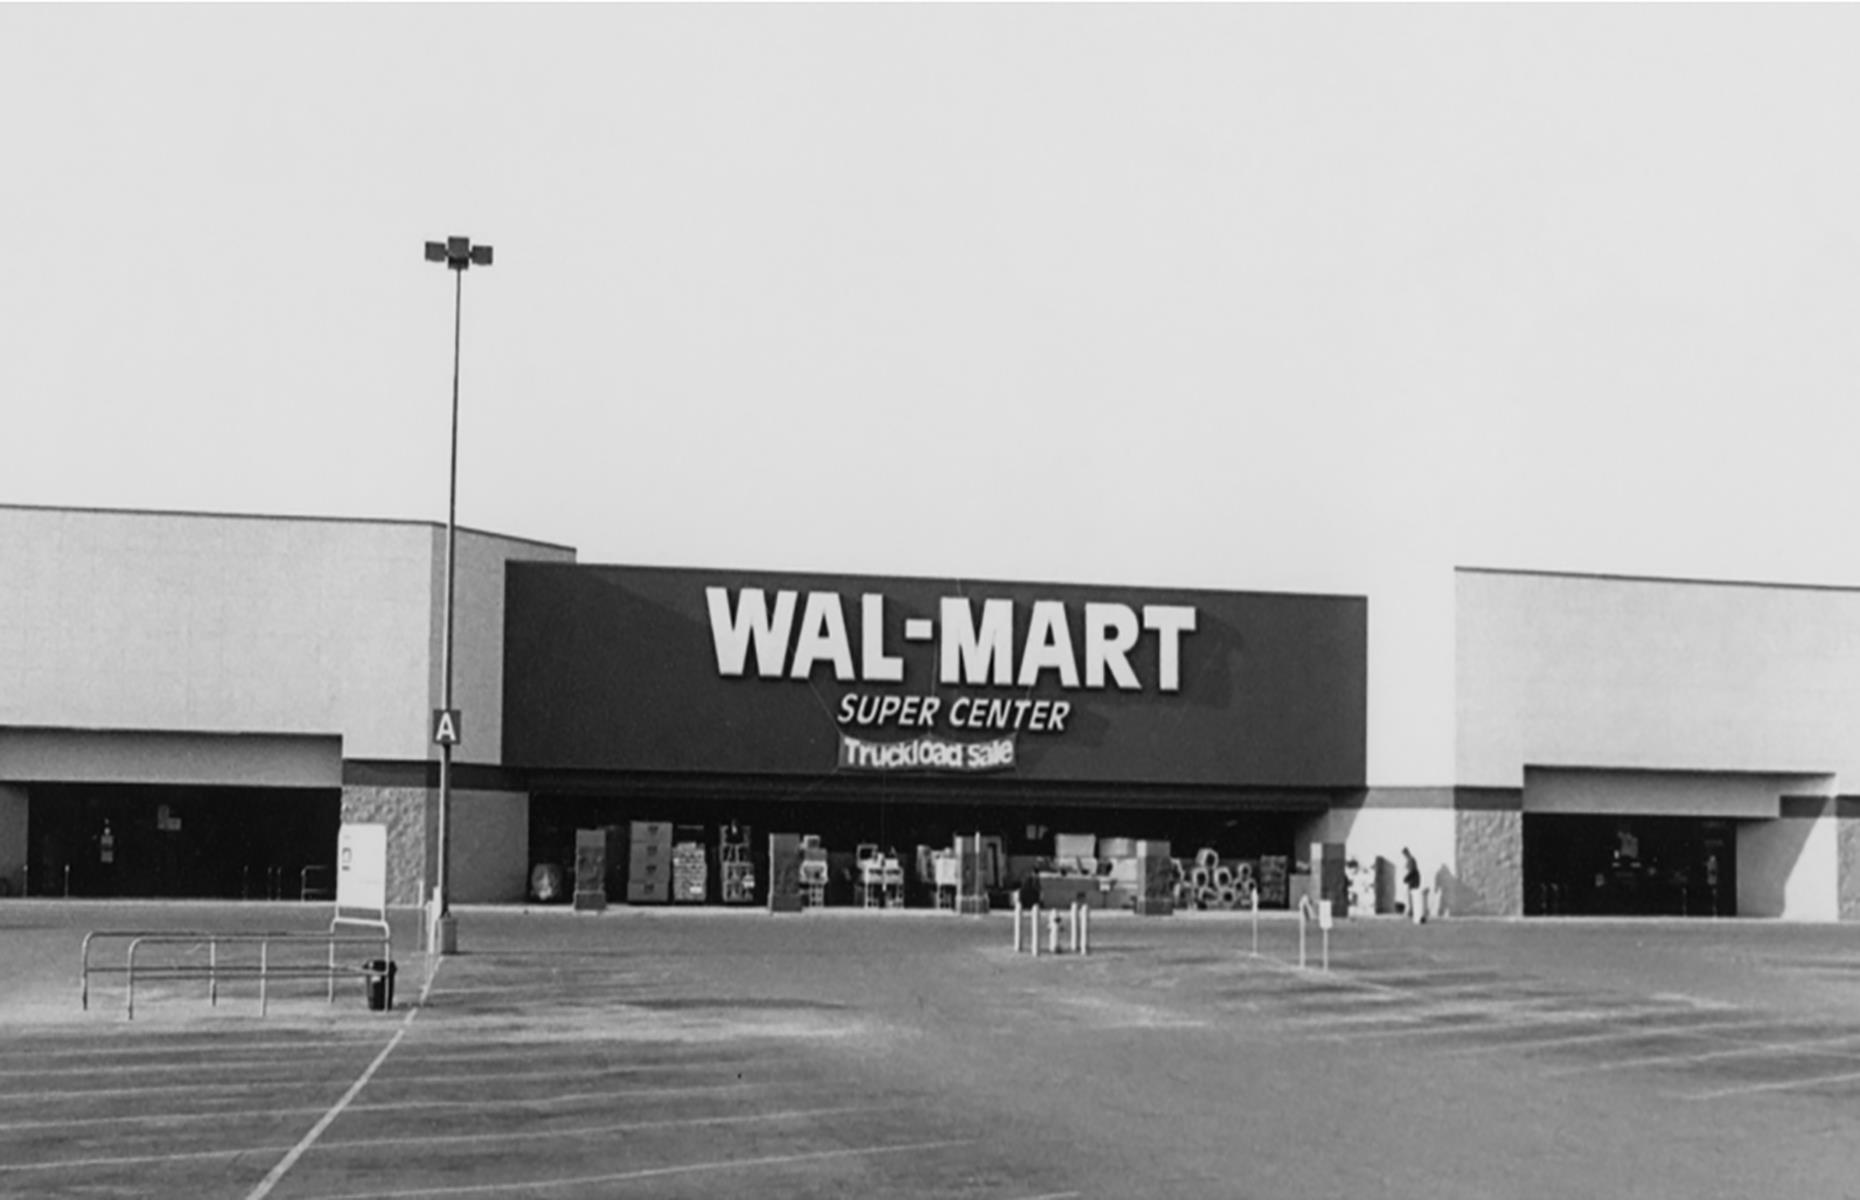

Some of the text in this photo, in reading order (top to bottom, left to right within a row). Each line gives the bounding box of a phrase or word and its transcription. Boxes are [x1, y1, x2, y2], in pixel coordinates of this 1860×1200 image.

[706, 587, 1197, 690] WAL-MART
[436, 712, 457, 741] A
[838, 693, 1070, 731] SUPER CENTER
[844, 737, 1014, 768] Truckload sale
